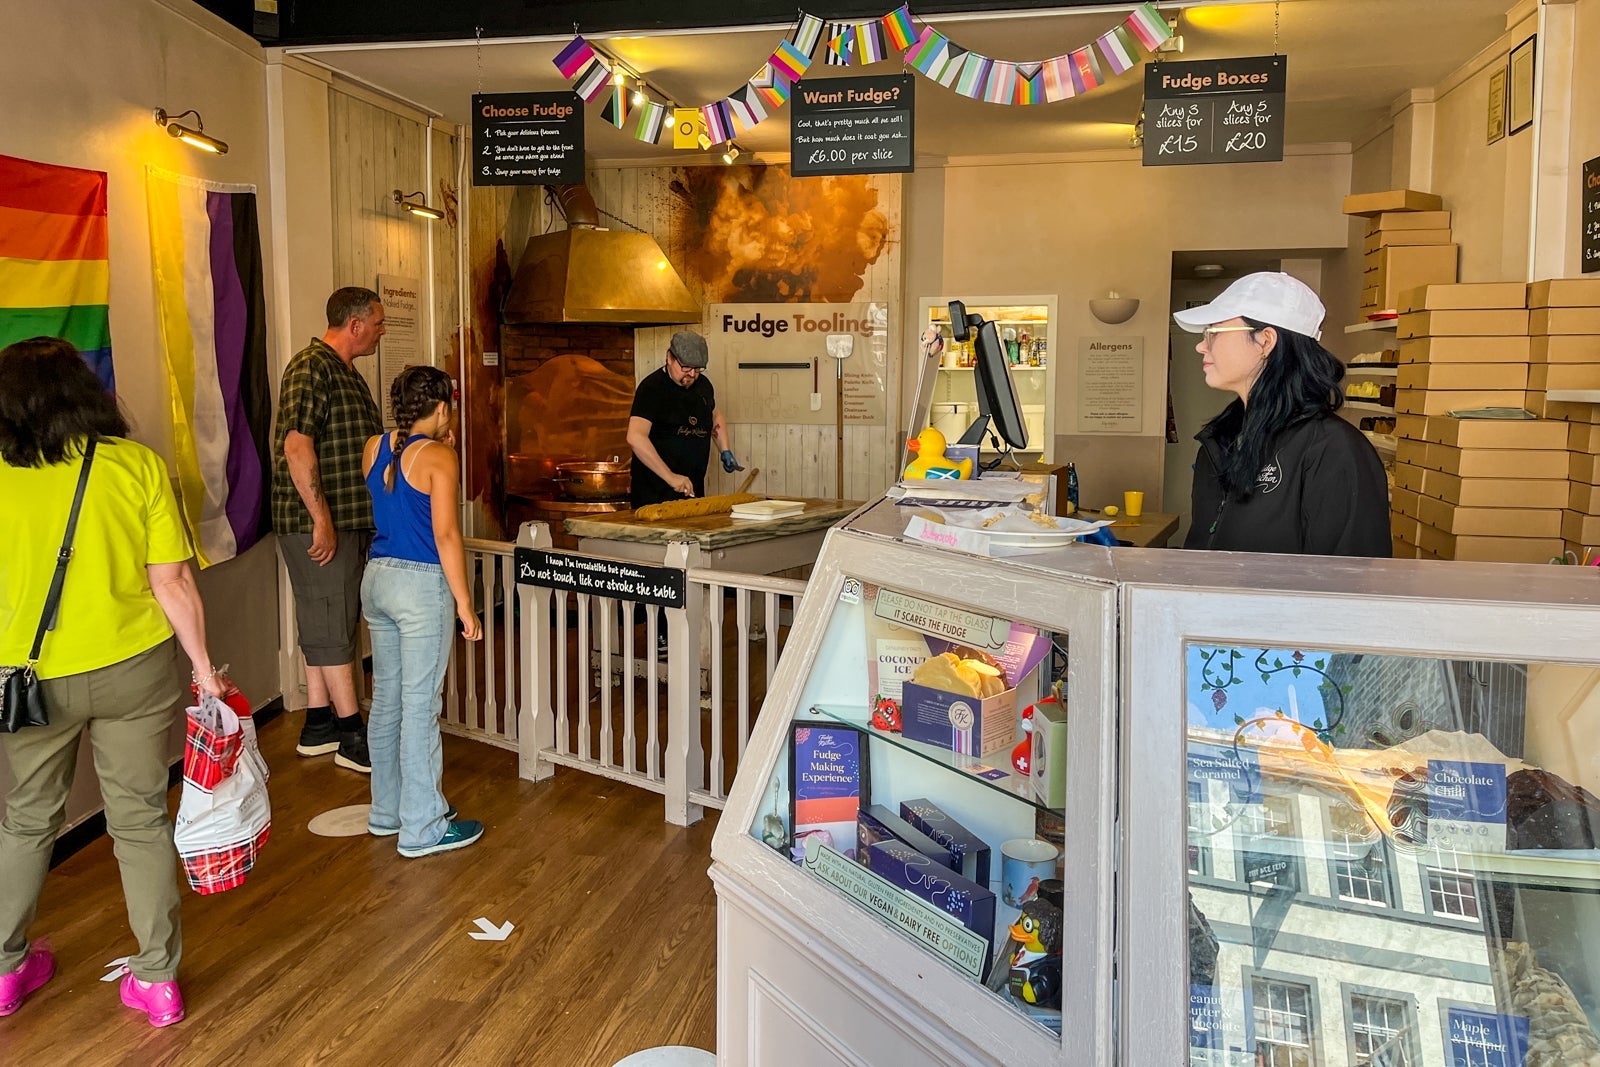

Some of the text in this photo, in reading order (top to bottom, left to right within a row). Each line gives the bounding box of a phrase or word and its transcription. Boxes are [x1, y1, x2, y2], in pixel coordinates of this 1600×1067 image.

[1162, 72, 1269, 91] Fudge Boxes
[803, 87, 900, 104] Want Fudge?
[482, 103, 573, 119] Choose Fudge
[1159, 103, 1199, 121] Any 3
[1226, 100, 1267, 117] Any 5
[815, 118, 832, 127] that's
[833, 119, 853, 128] pretty
[854, 117, 870, 125] much
[871, 116, 879, 124] all
[1155, 116, 1204, 130] slices for
[1223, 111, 1272, 127] slices for
[795, 135, 810, 144] But
[811, 135, 824, 143] how
[825, 134, 841, 142] much
[878, 133, 890, 142] you
[1158, 134, 1198, 155] £15
[1225, 132, 1266, 153] £20
[808, 148, 894, 165] £6.00 per slice
[482, 166, 492, 175] 3.
[723, 313, 874, 338] Fudge Tooling
[1089, 342, 1133, 353] Allergens
[545, 555, 549, 564] I
[549, 556, 564, 567] know
[564, 557, 575, 568] I'm
[607, 564, 619, 574] but
[520, 562, 677, 600] Do not touch, lick or stroke the table
[904, 598, 916, 610] DO
[916, 602, 933, 614] NOT
[934, 606, 948, 617] TAP
[949, 610, 962, 622] THE
[965, 615, 990, 630] GLASS
[894, 609, 967, 638] IT SCARES THE FUDGE
[894, 665, 912, 674] ICE
[813, 750, 842, 761] Fudge
[1193, 757, 1250, 769] Sea Salted
[810, 762, 845, 774] Making
[1193, 769, 1241, 779] Caramel
[802, 772, 853, 784] Experience
[1434, 772, 1494, 786] Chocolate
[817, 862, 830, 876] ASK
[830, 869, 853, 889] ABOUT
[853, 883, 868, 900] OUR
[870, 892, 894, 916] VEGAN
[900, 912, 922, 933] DAIRY
[922, 926, 941, 945] FREE
[942, 938, 978, 969] OPTIONS
[1454, 1019, 1490, 1035] Maple
